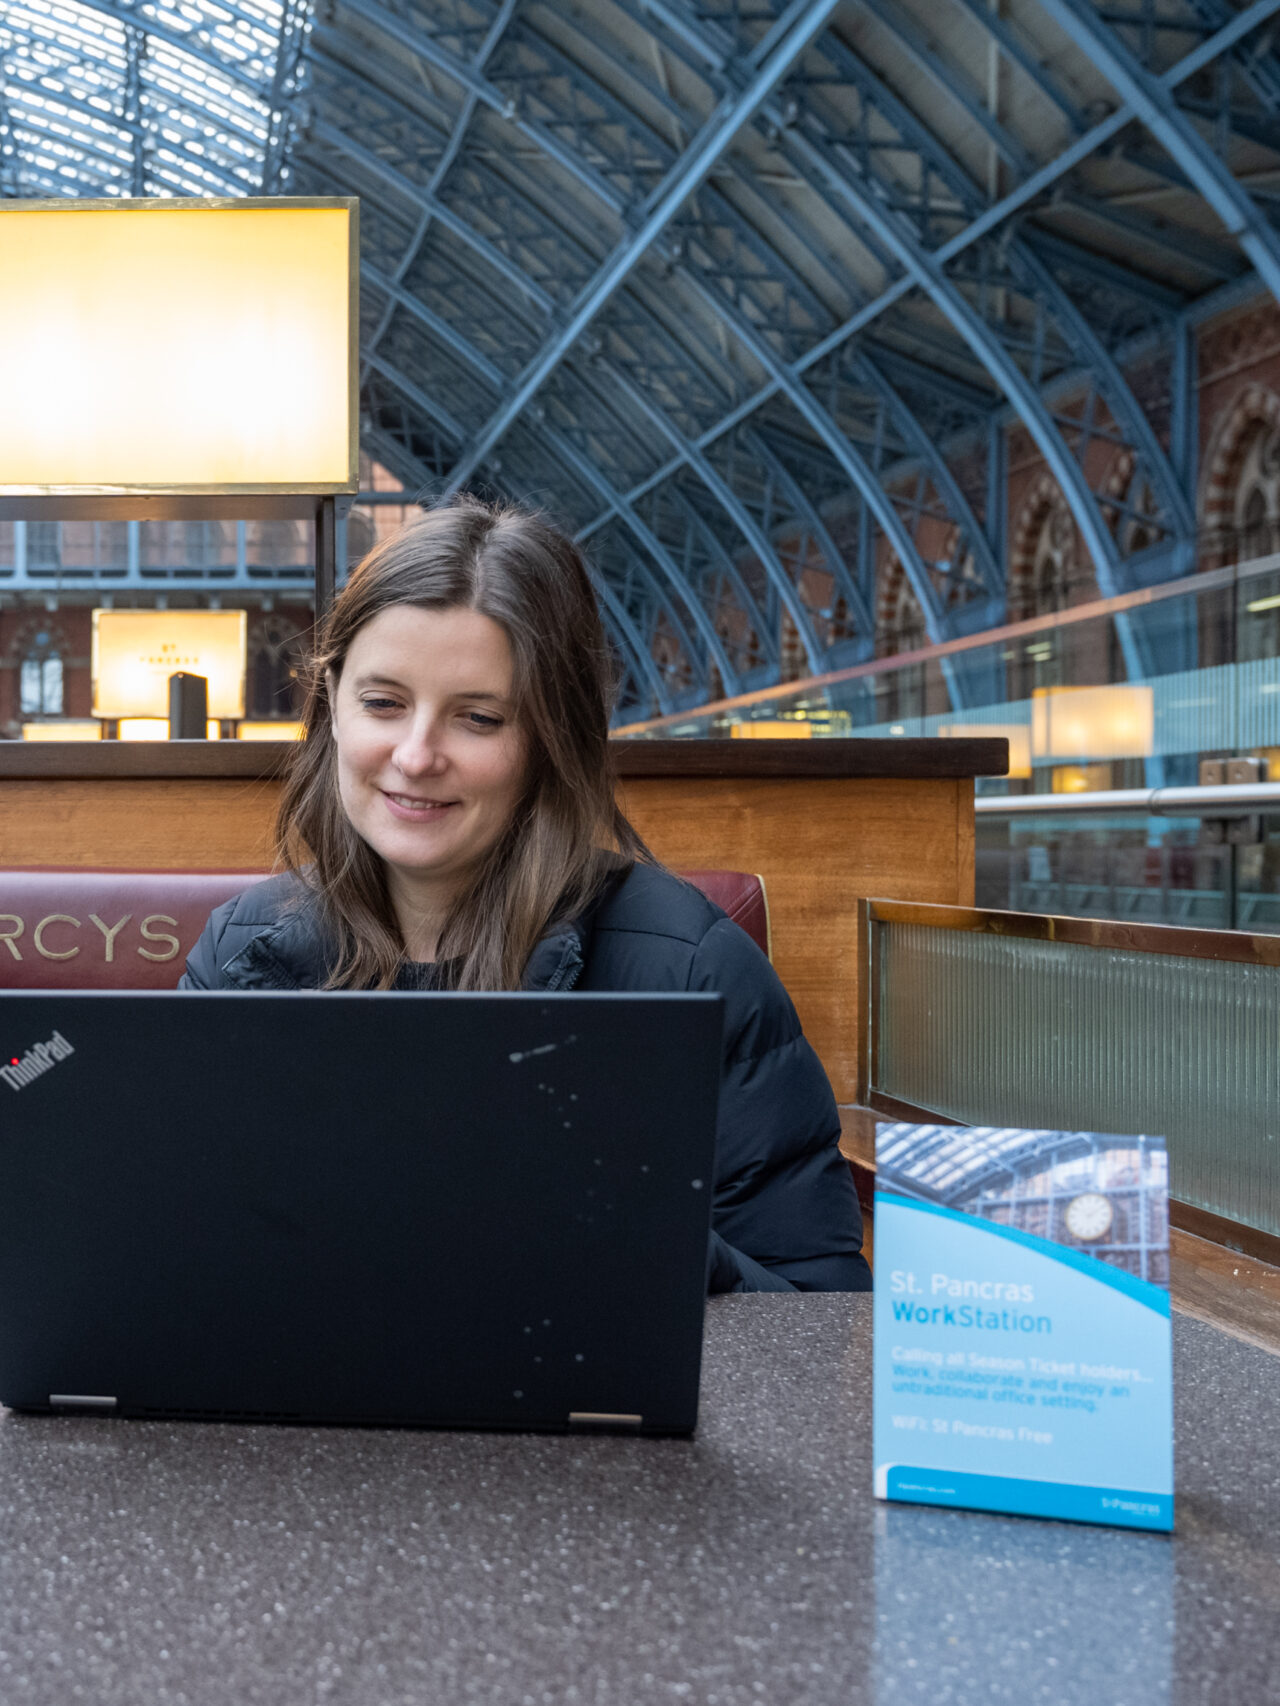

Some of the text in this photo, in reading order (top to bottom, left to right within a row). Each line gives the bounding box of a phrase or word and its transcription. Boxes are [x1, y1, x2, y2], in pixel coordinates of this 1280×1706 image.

[890, 1270, 1034, 1303] St. Pancras
[892, 1300, 1052, 1335] WorkStation
